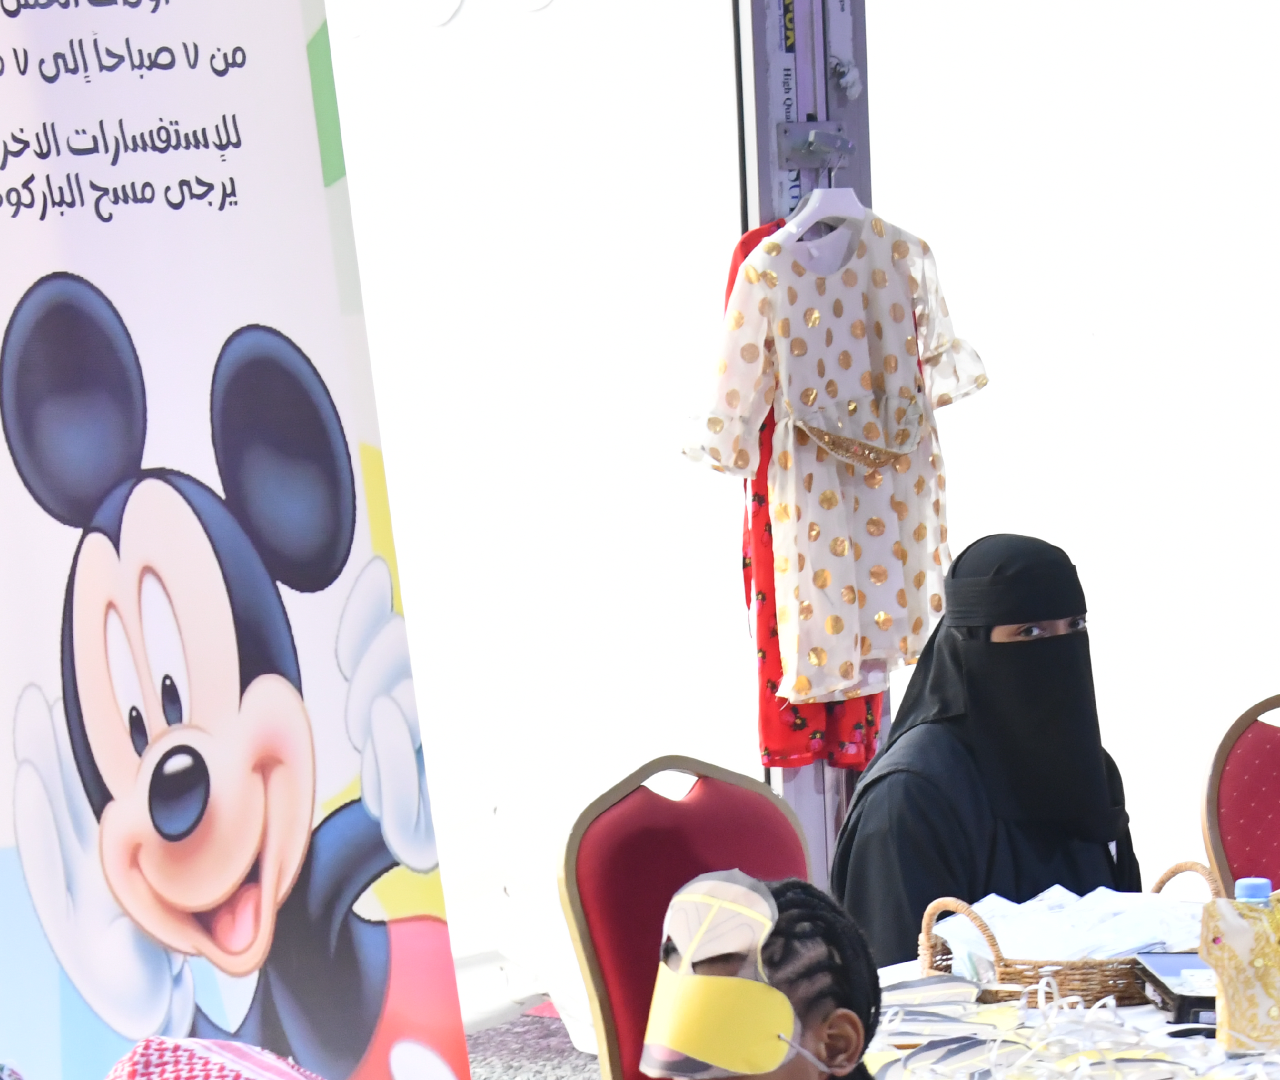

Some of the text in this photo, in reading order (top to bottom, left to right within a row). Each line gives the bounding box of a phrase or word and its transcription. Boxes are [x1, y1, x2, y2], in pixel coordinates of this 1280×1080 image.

[38, 37, 92, 84] إلى
[209, 45, 247, 77] من
[89, 178, 156, 223] مسح
[164, 175, 239, 212] يرجى
